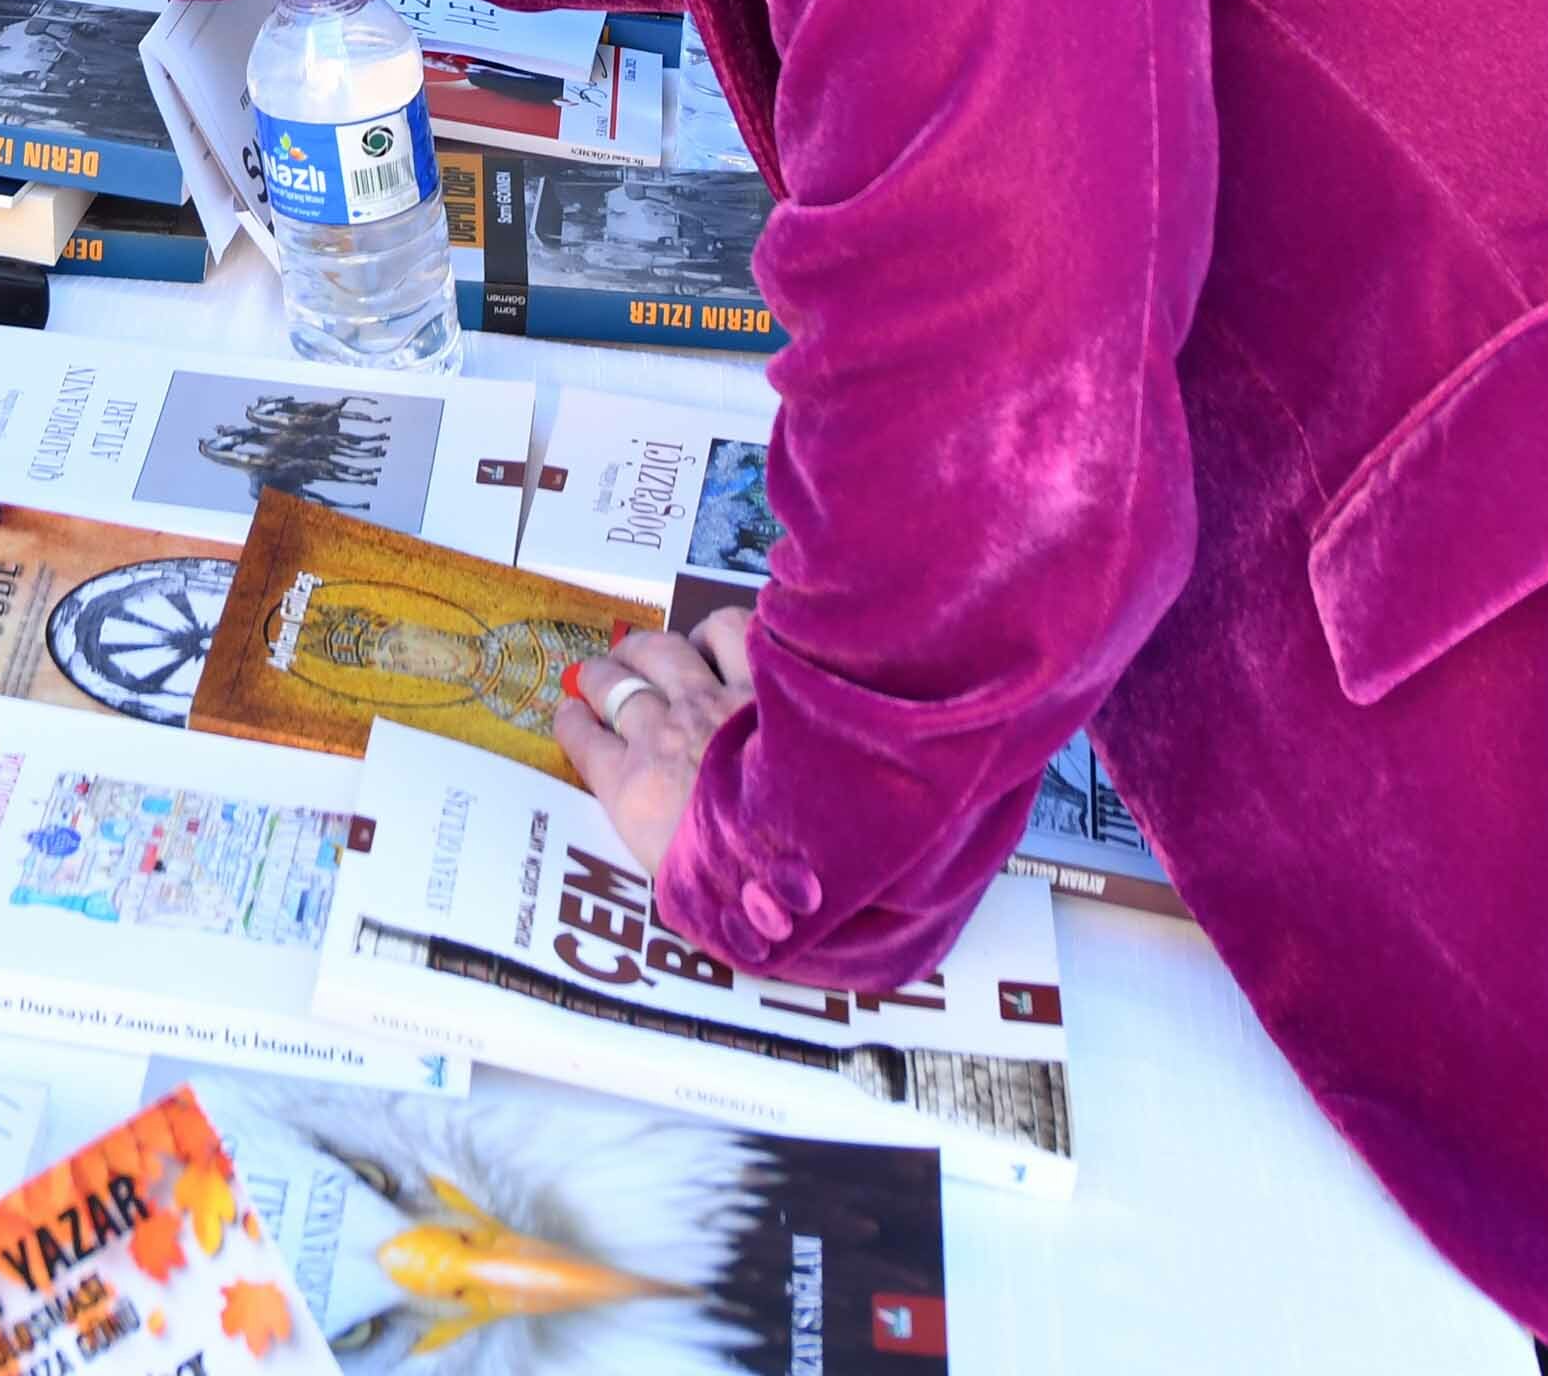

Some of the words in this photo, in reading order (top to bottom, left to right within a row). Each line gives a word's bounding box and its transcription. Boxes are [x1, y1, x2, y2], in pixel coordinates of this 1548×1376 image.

[23, 146, 100, 177] DERİN
[263, 151, 327, 193] Nazlı
[487, 293, 526, 305] Gökmen
[494, 305, 517, 316] Sami
[630, 301, 692, 328] İZLER
[701, 307, 772, 333] DERİN
[606, 438, 696, 549] Boğaziçi
[552, 845, 656, 988] ÇEM
[19, 996, 109, 1032] Dursaydı
[114, 1012, 181, 1041] Zaman
[184, 1024, 219, 1046] Sur
[3, 1174, 150, 1292] YAZAR
